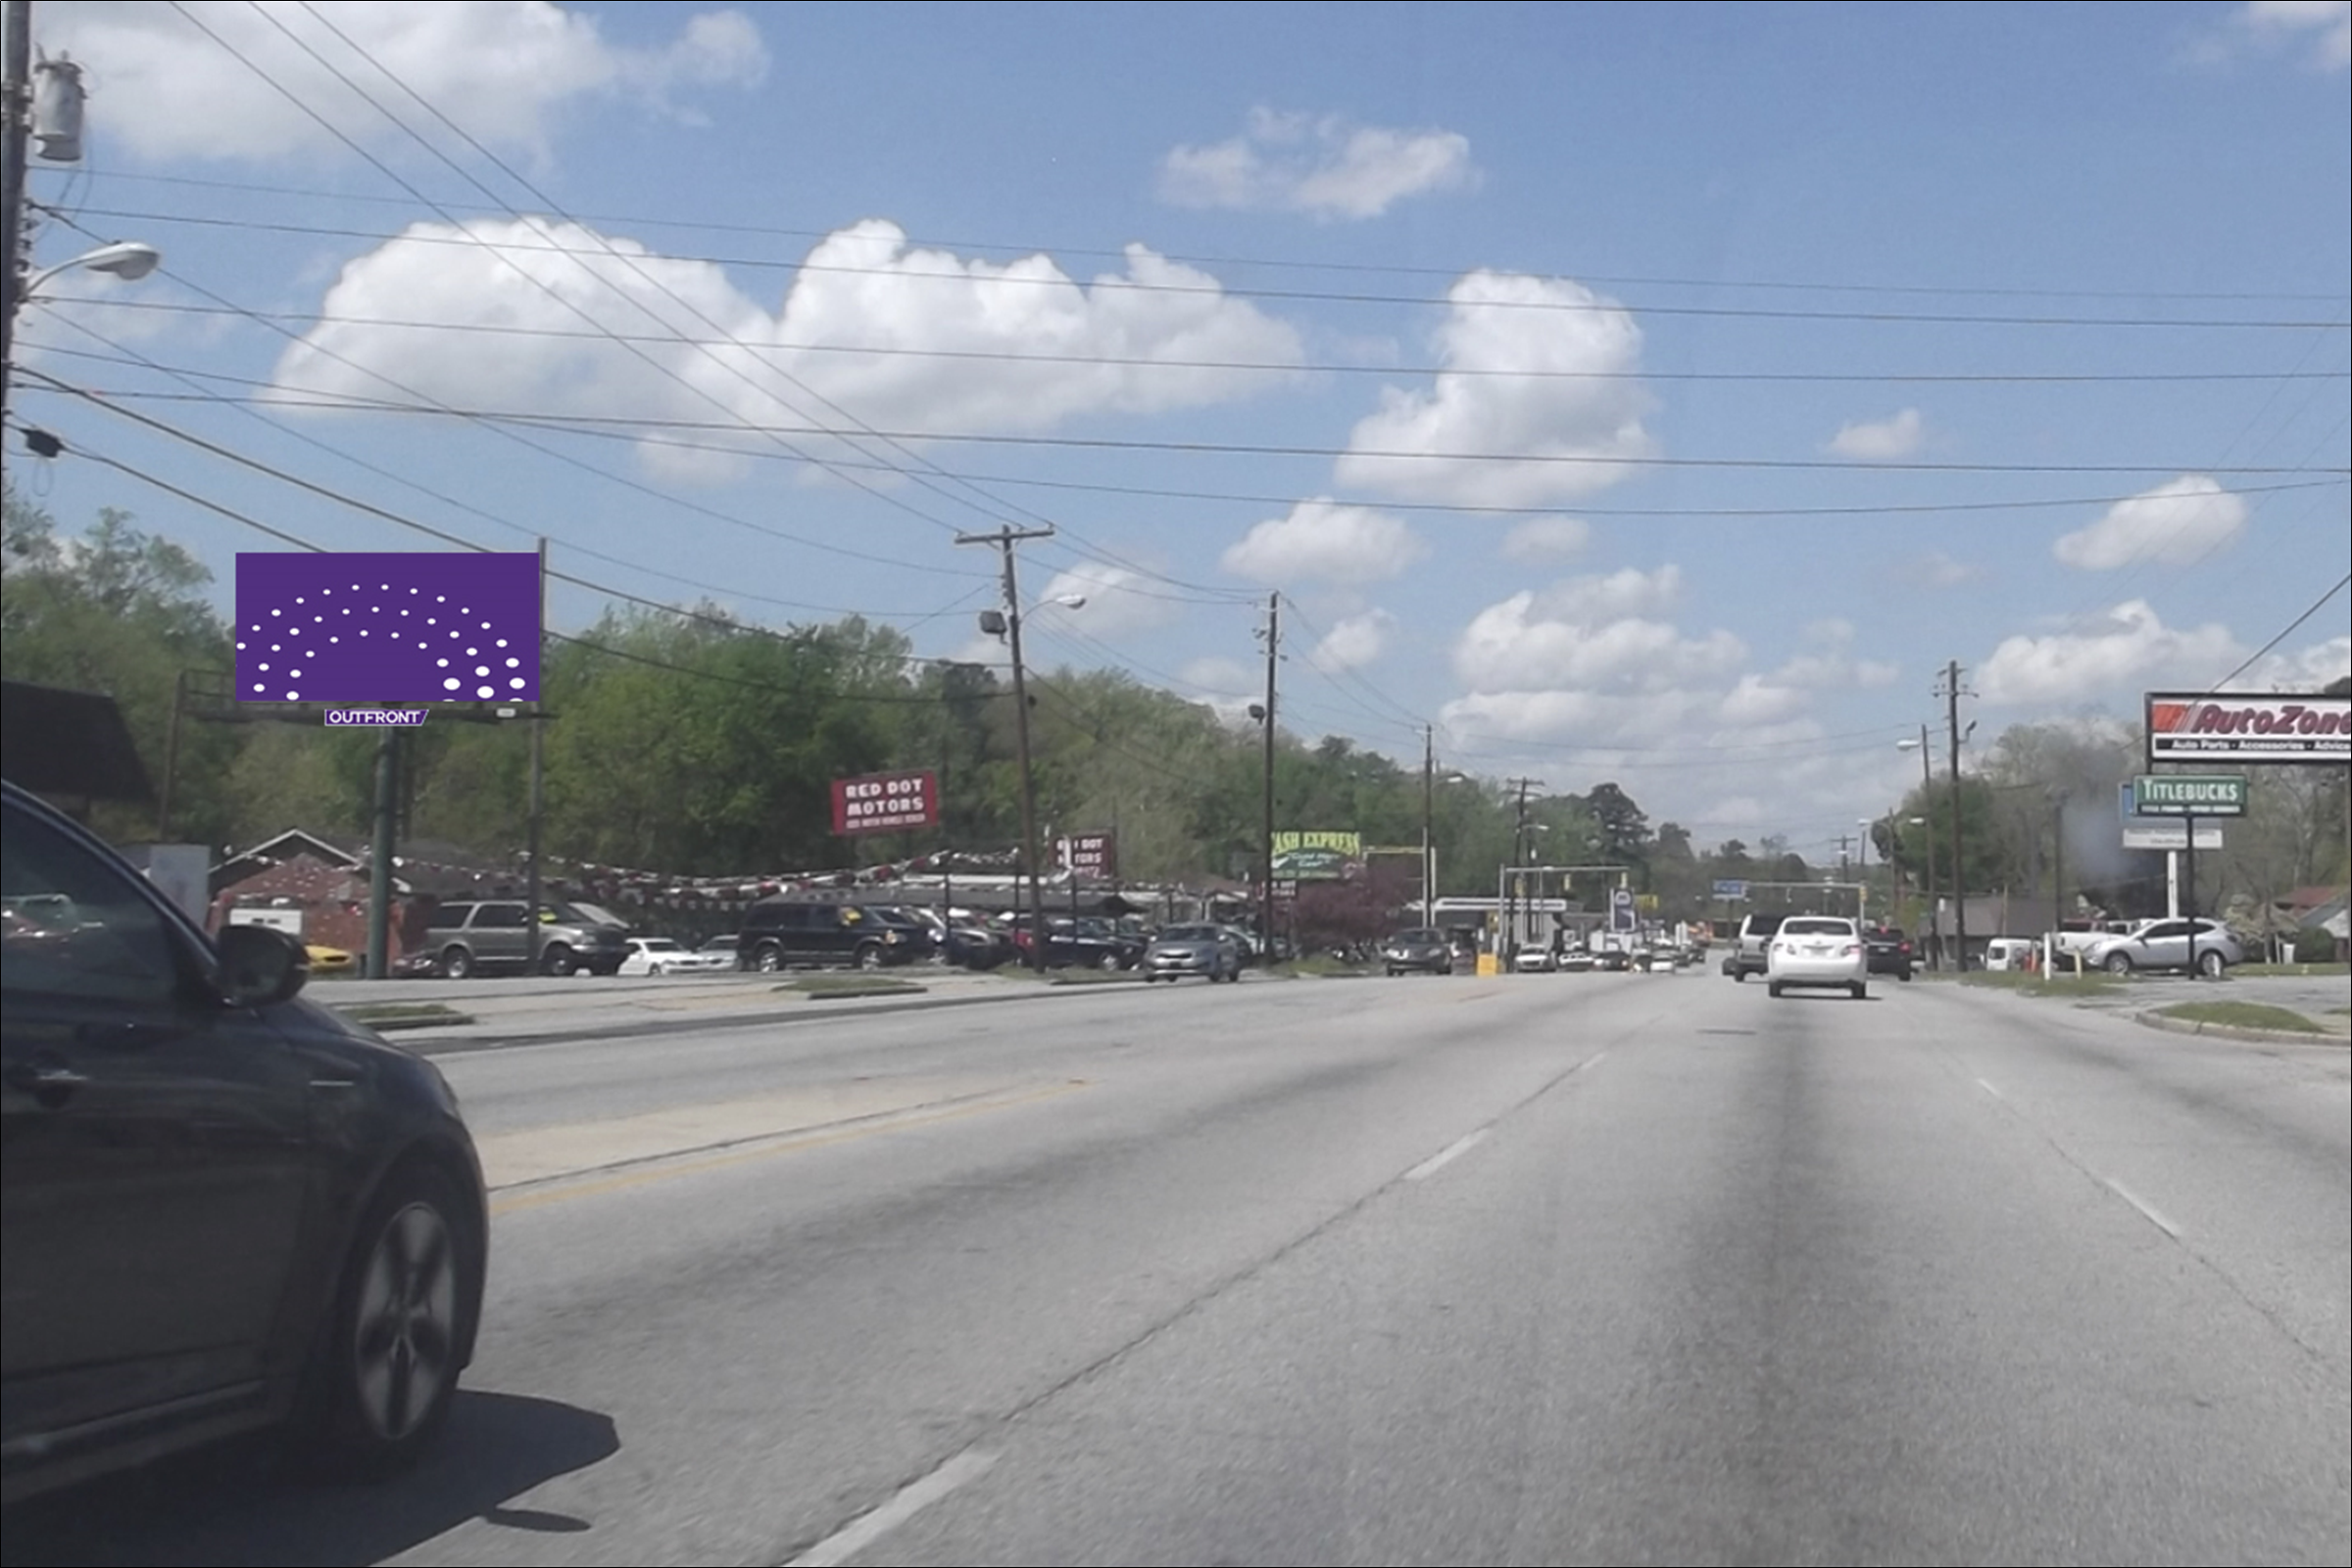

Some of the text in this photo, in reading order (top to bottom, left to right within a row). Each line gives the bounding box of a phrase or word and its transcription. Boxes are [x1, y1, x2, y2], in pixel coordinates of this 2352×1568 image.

[328, 710, 421, 724] OUTFRONT
[2172, 740, 2198, 750] Auto
[2201, 740, 2230, 750] Parts
[846, 778, 923, 799] RED DOT
[847, 796, 924, 817] MOTORS
[1271, 831, 1300, 858] ASH
